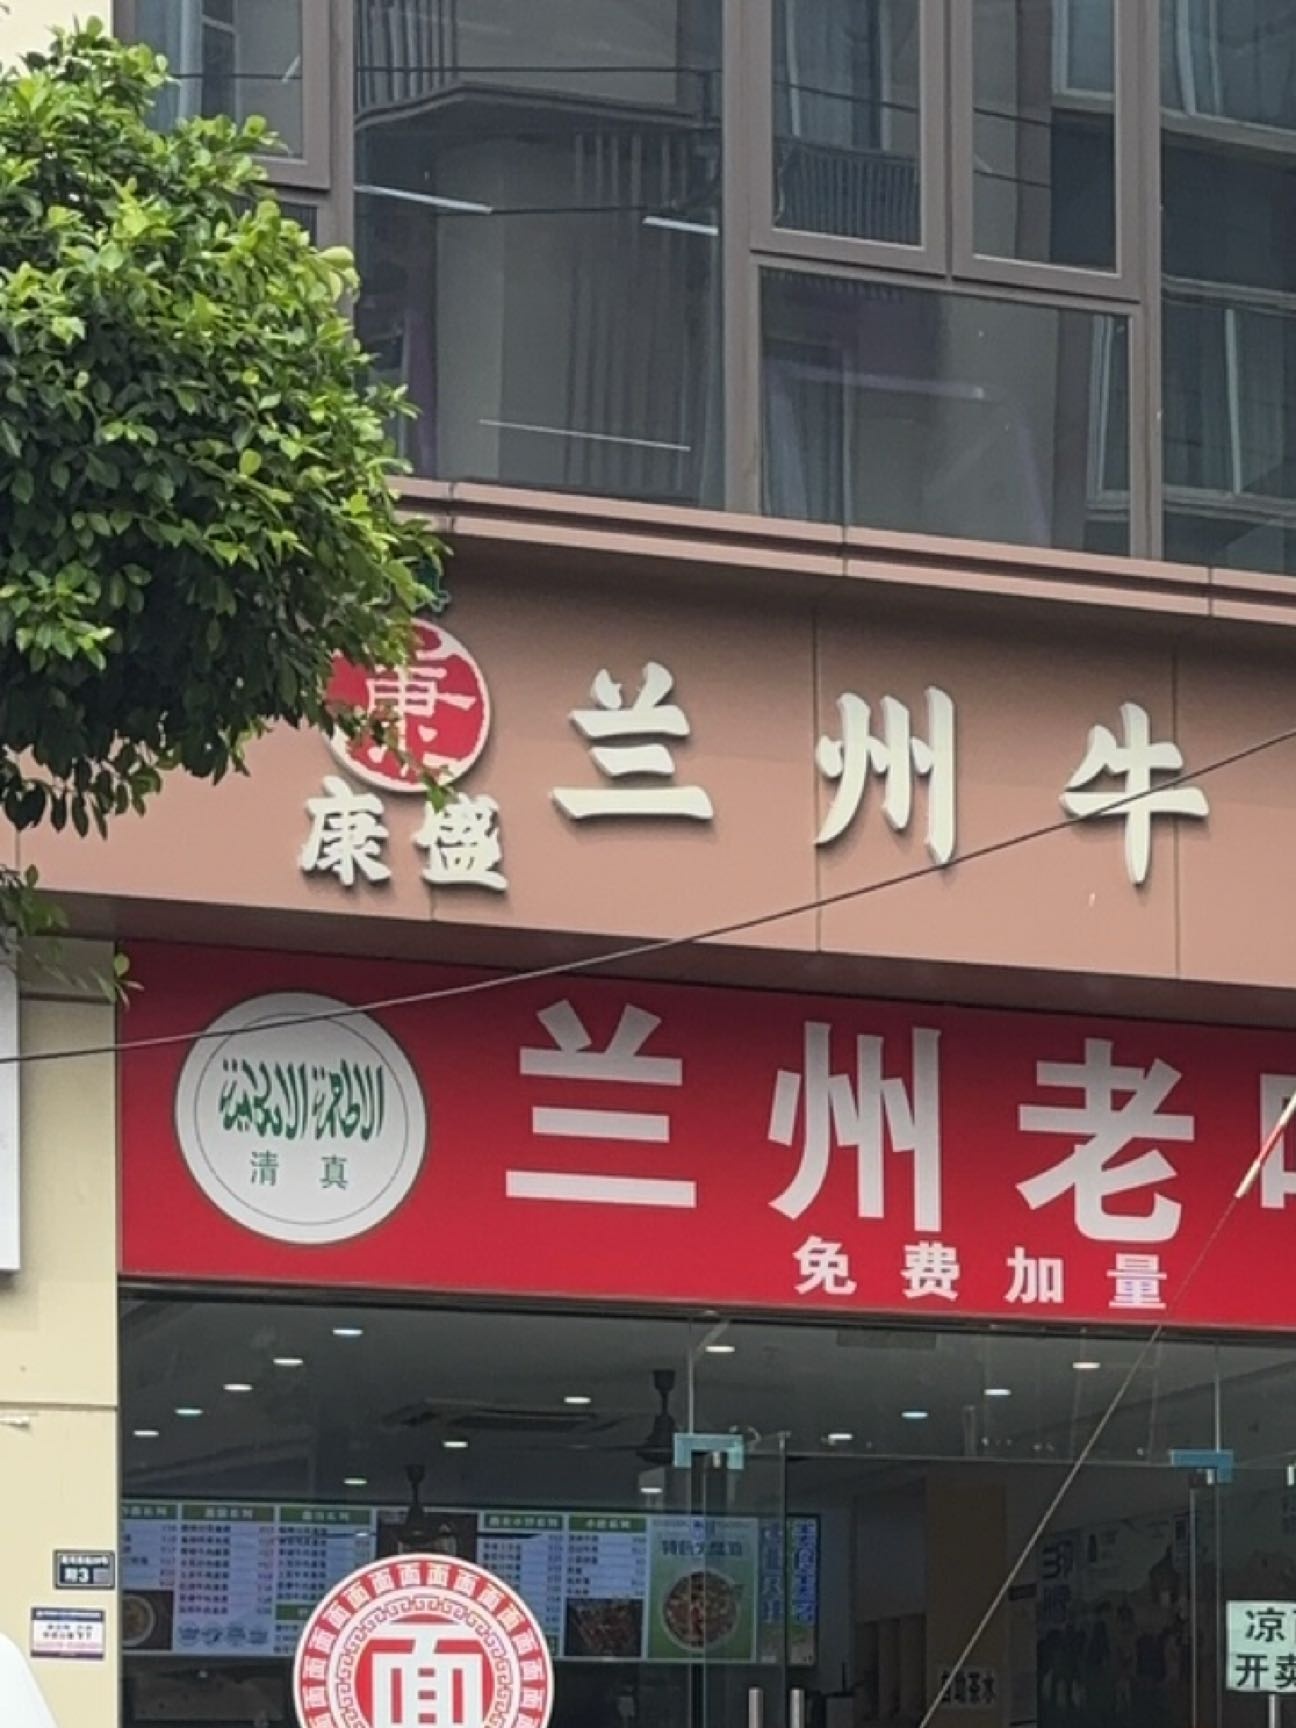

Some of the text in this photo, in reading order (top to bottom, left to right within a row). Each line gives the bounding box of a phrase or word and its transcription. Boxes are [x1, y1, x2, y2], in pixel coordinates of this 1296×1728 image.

[299, 775, 507, 892] 康盛
[250, 1150, 348, 1190] 清真
[794, 1234, 1168, 1312] 免费加量
